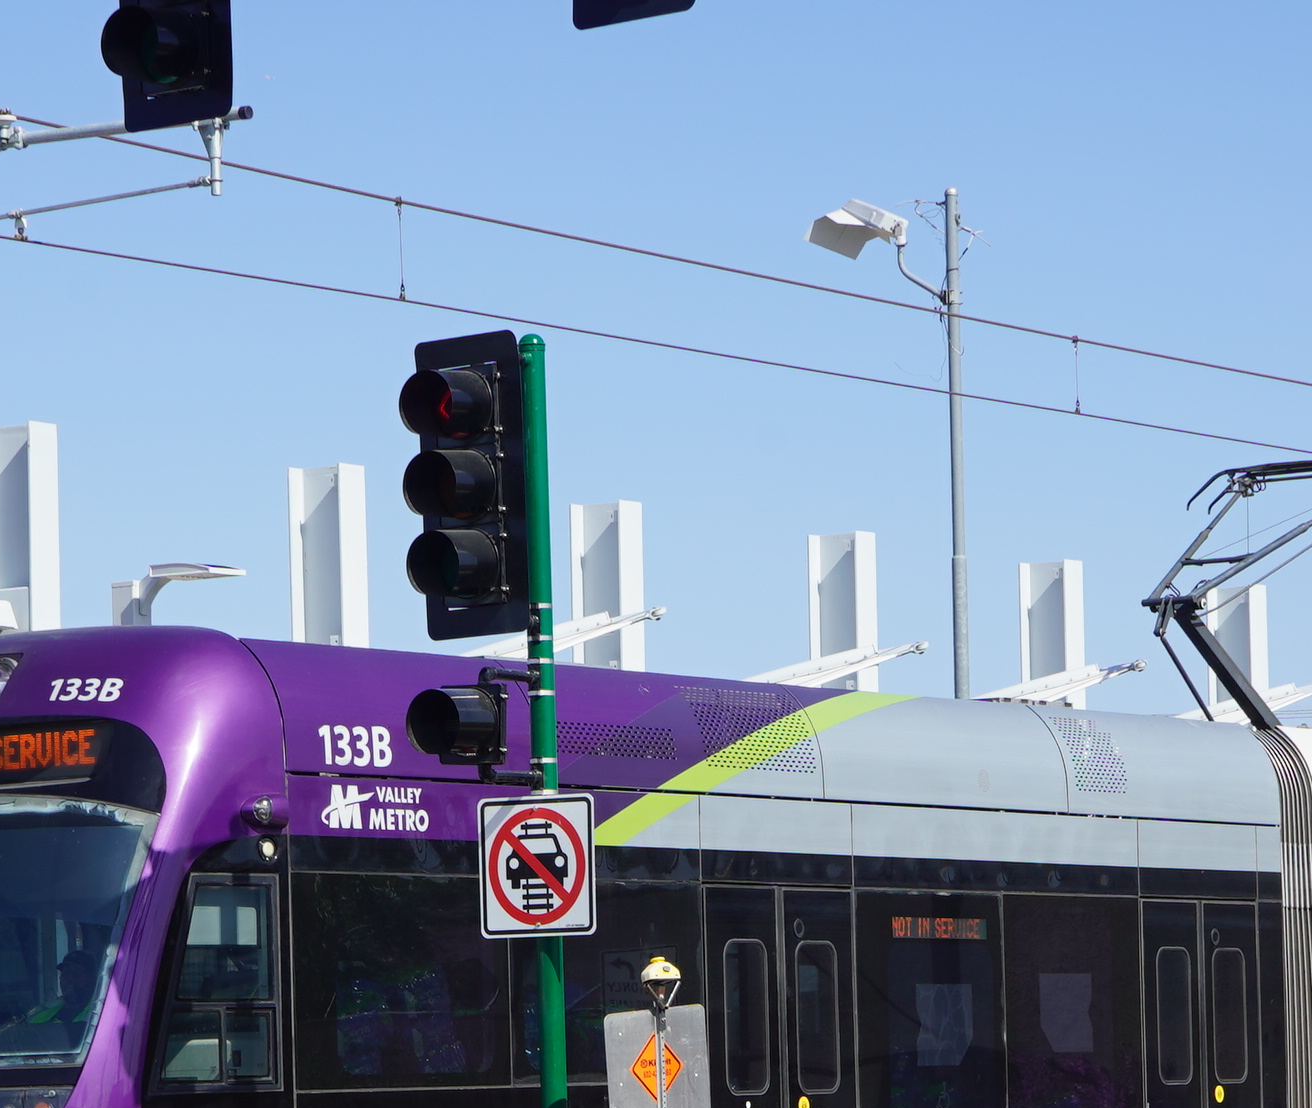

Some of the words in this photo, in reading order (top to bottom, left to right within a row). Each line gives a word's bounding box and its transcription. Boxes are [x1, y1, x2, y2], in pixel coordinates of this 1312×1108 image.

[49, 677, 124, 702] 133B
[318, 724, 392, 768] 133B
[375, 785, 423, 804] VALLEY
[369, 808, 430, 832] METRO
[891, 916, 912, 937] NOT
[917, 917, 930, 938] IN
[934, 918, 980, 939] SERVICE
